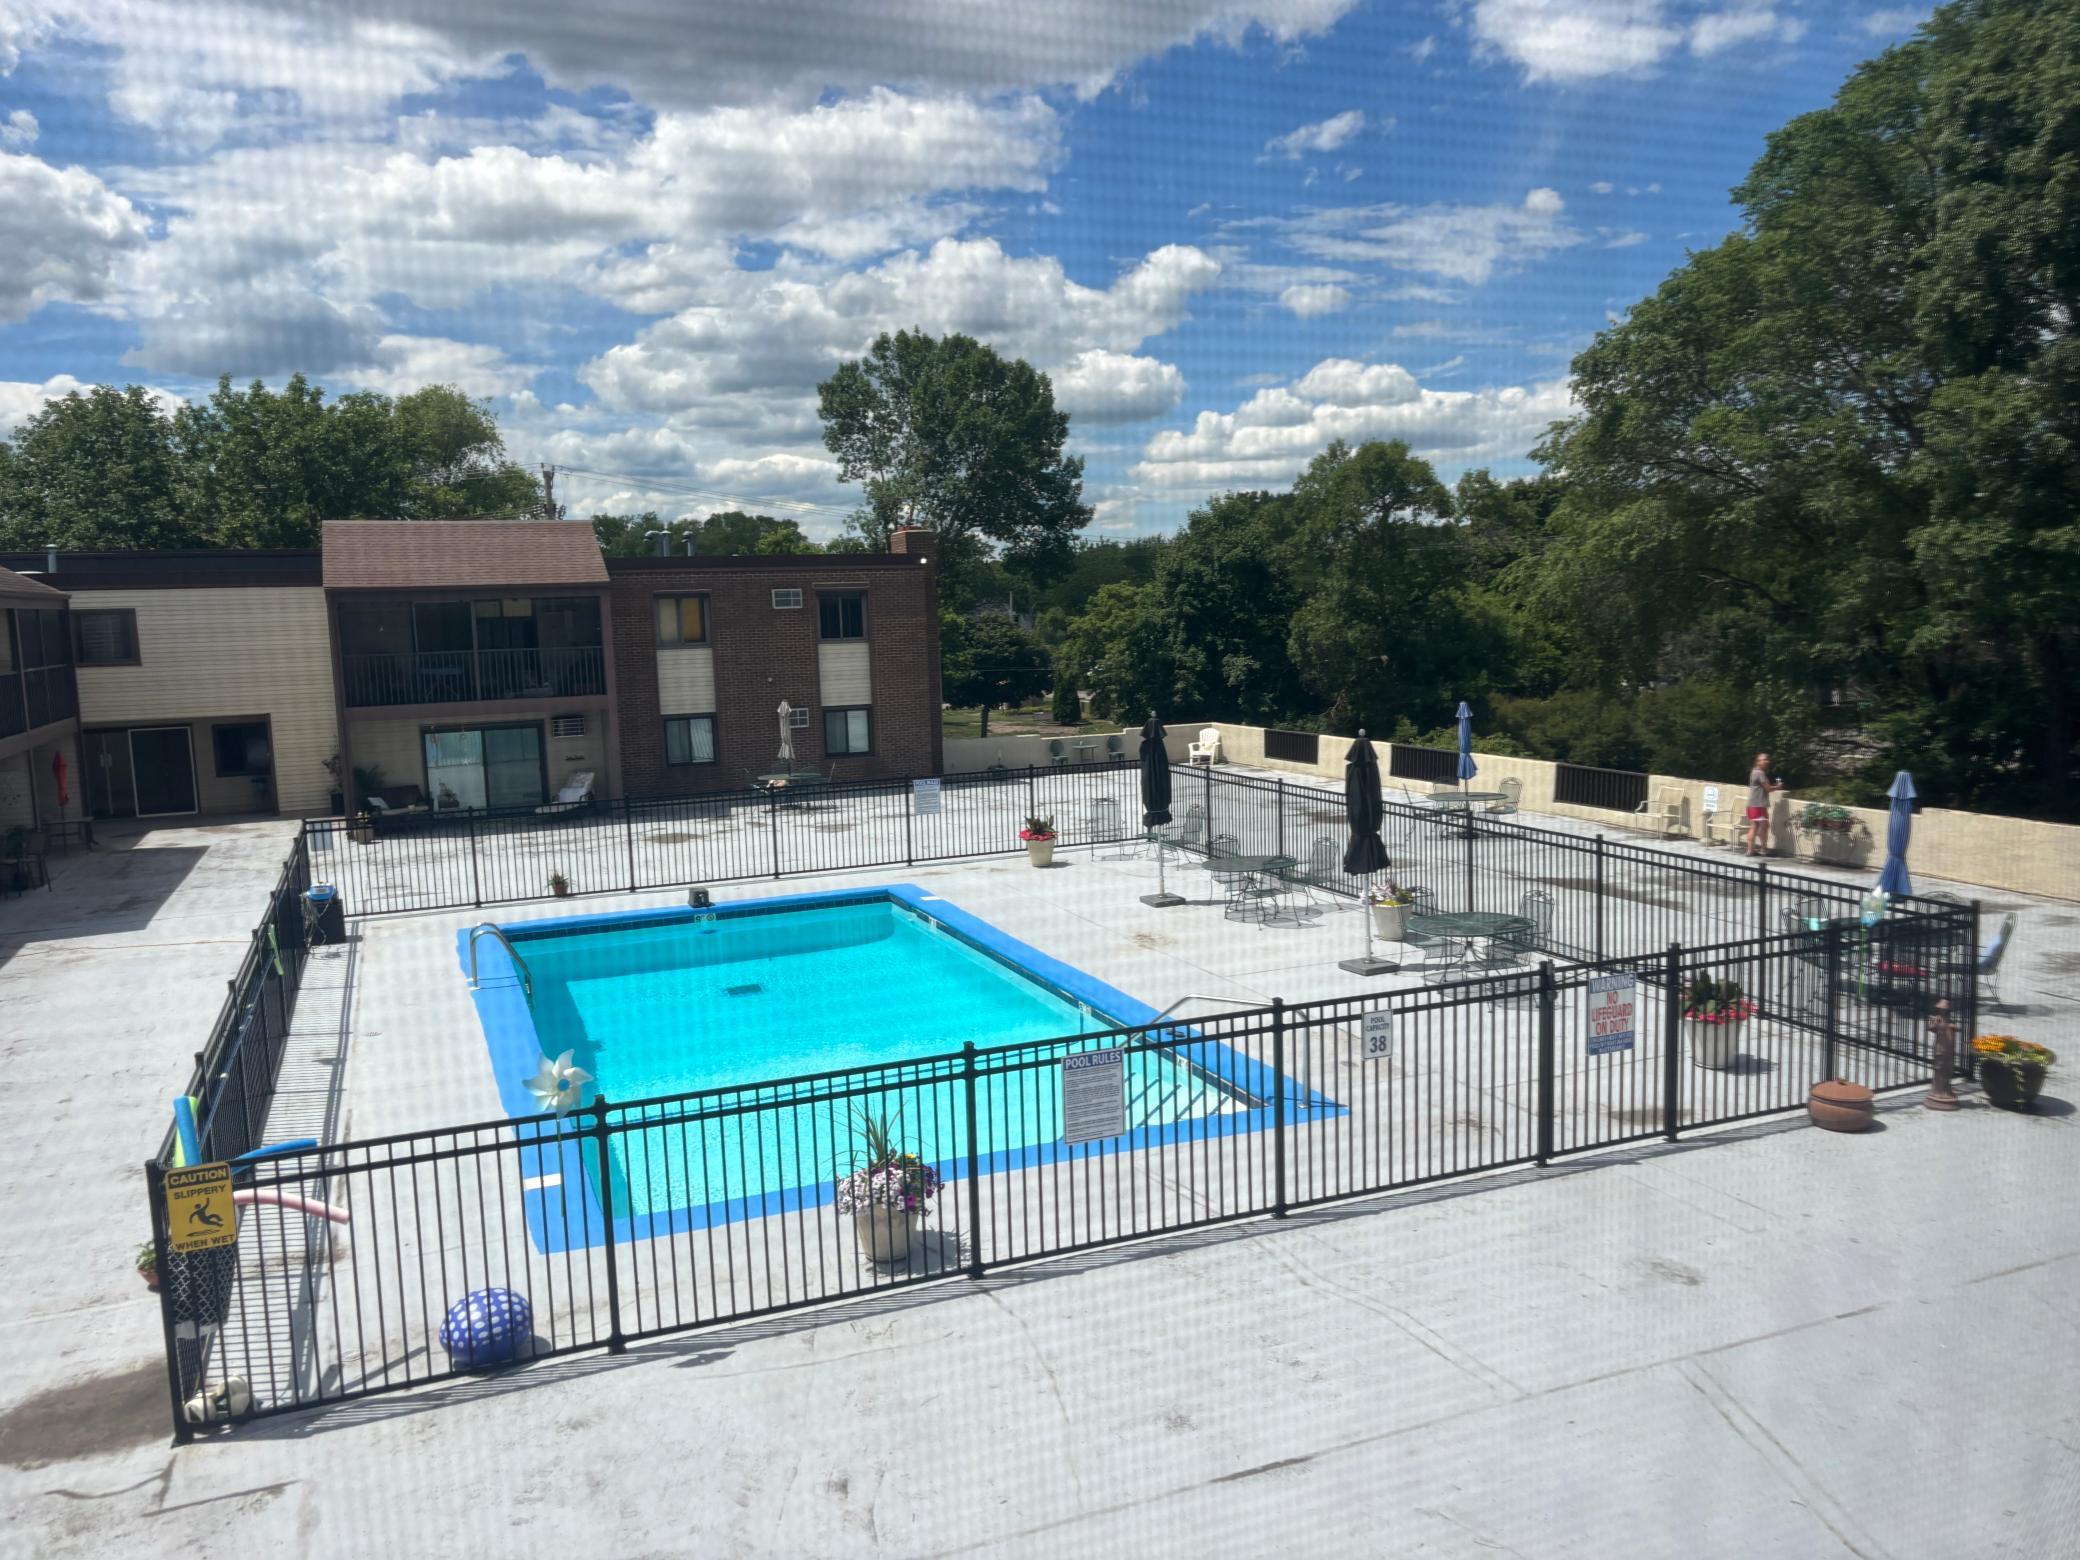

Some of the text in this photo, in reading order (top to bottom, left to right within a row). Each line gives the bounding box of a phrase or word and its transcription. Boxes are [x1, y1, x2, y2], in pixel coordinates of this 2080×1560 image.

[1591, 974, 1634, 993] WARNING
[1607, 991, 1618, 1005] NO
[1370, 1016, 1385, 1024] POOL
[1591, 1003, 1633, 1022] LIFEGUARD
[1365, 1022, 1390, 1032] CAPACITY
[1596, 1018, 1629, 1036] ON DUTY
[1369, 1035, 1387, 1053] 38
[1065, 1052, 1121, 1070] POOL RULES
[170, 1168, 227, 1186] CAUTION
[174, 1184, 226, 1200] SLIPPERY
[175, 1234, 235, 1251] WHEN WET
